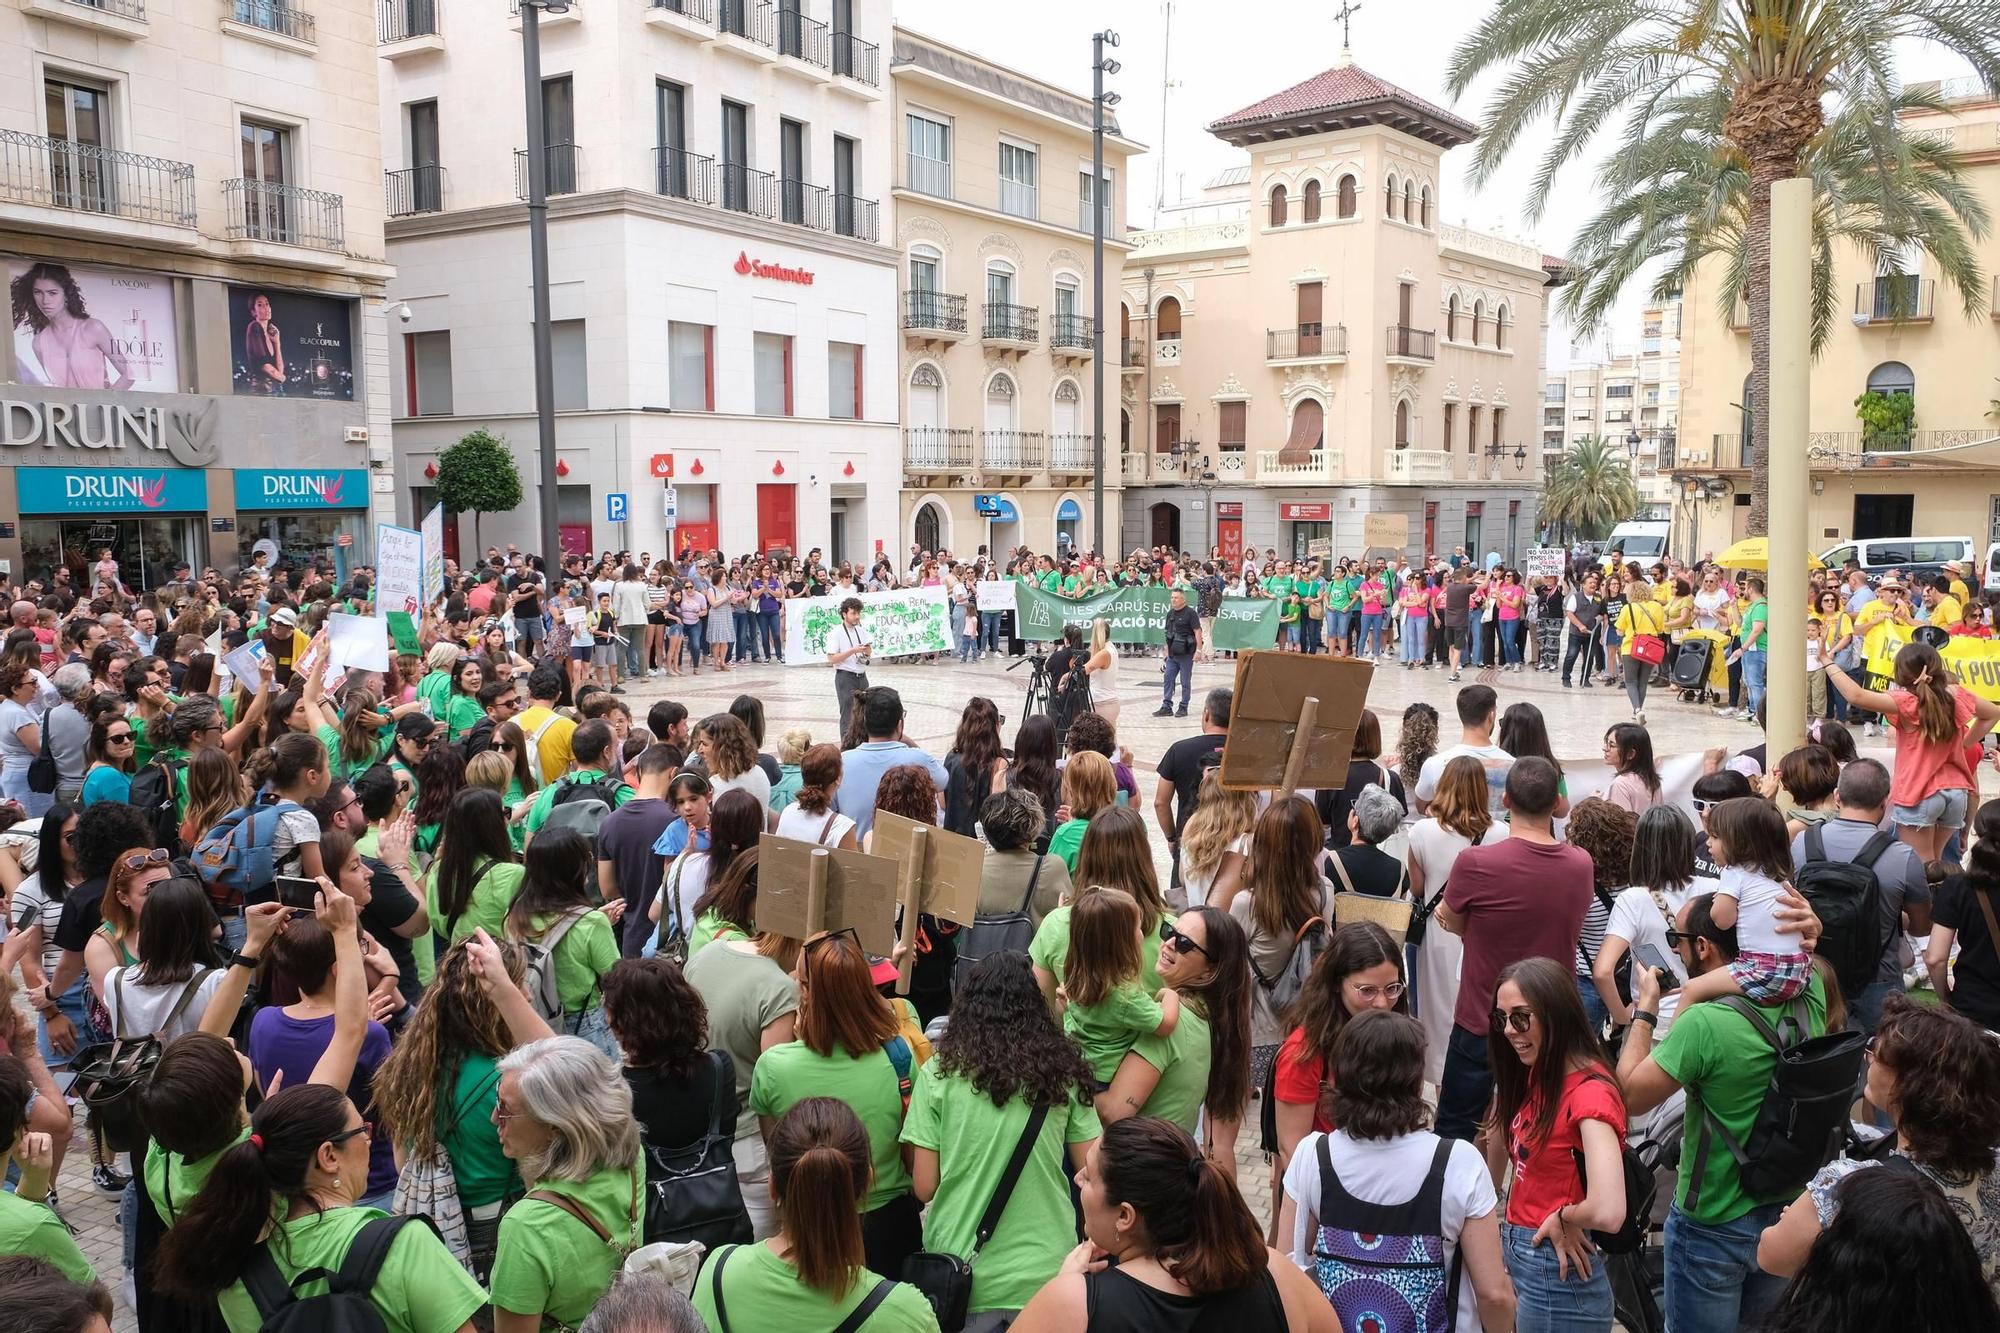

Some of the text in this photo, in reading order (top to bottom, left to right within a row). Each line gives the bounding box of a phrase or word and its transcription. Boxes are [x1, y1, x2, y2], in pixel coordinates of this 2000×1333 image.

[751, 258, 815, 285] Santander
[110, 278, 152, 290] LANCÔME
[0, 399, 169, 450] DRUNI
[65, 475, 145, 498] DRUNI
[263, 475, 327, 496] DRUNI
[610, 496, 624, 519] P
[1062, 604, 1094, 615] L'IES
[1097, 598, 1150, 614] CARRÚS
[1153, 602, 1170, 614] EN
[1242, 610, 1262, 622] DE
